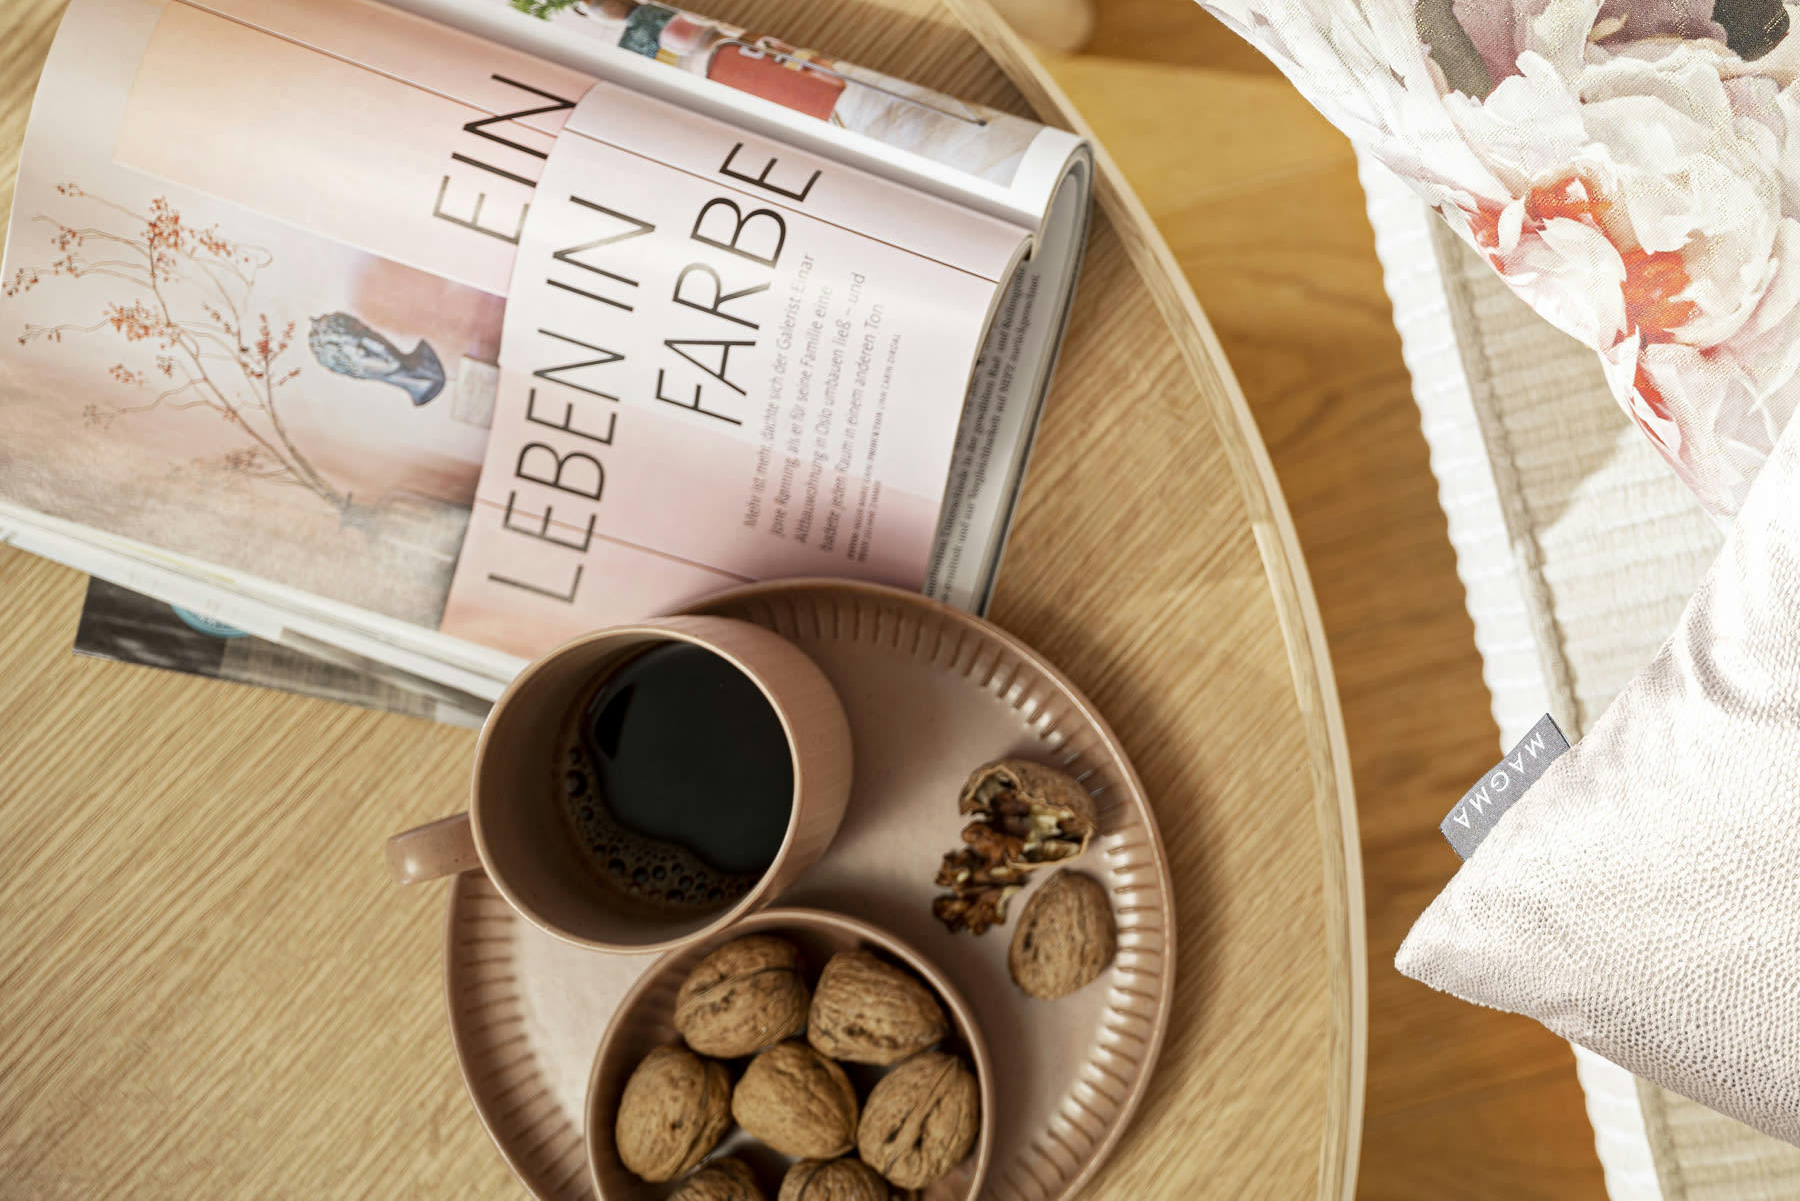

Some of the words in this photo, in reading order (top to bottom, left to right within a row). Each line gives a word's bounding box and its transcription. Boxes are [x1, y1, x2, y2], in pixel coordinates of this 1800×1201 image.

[432, 74, 577, 245] EIN
[546, 195, 656, 312] IN
[655, 142, 822, 425] FARBE
[776, 296, 800, 350] Galerist
[799, 319, 823, 367] Familie
[812, 284, 833, 318] eine
[831, 319, 851, 345] ließ
[846, 272, 866, 304] und
[863, 302, 883, 330] Ton
[851, 333, 876, 386] anderen
[487, 328, 625, 605] LEBEN
[1453, 731, 1546, 830] MAGMA
